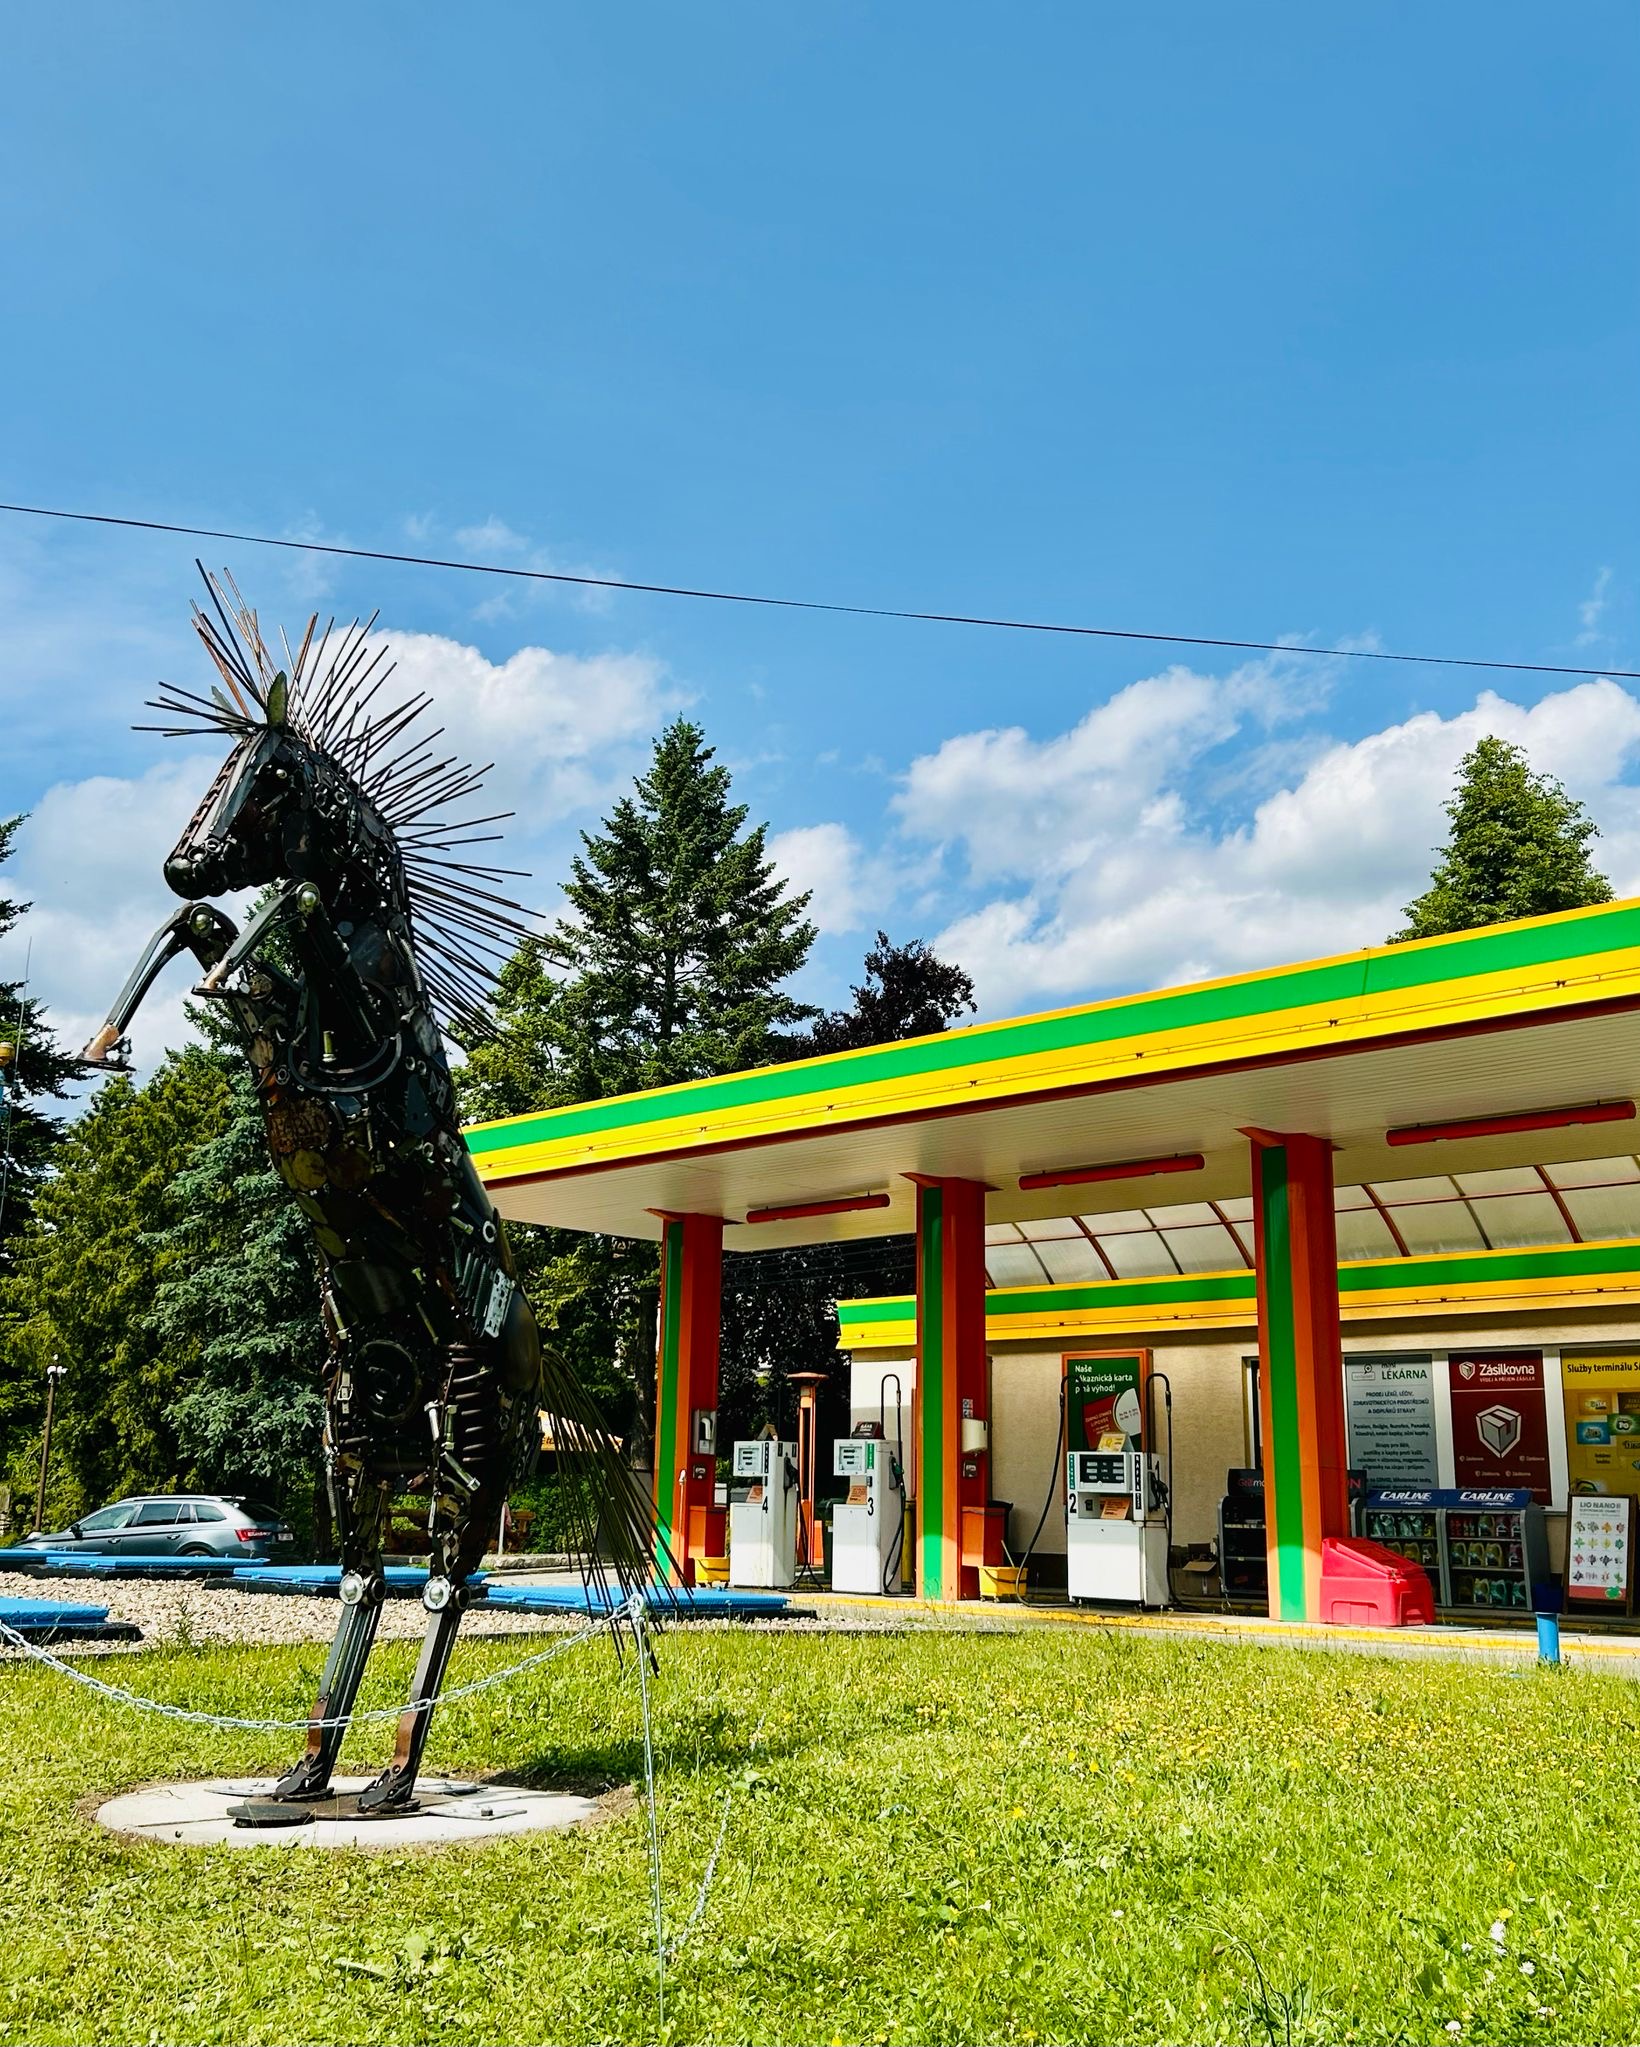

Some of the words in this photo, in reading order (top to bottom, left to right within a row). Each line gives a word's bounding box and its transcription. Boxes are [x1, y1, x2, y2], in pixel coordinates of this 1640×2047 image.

[1074, 1364, 1092, 1373] Naše
[1382, 1368, 1427, 1380] LÉKÁRNA
[1479, 1363, 1535, 1376] Zásilkovna
[1567, 1364, 1592, 1374] Služby
[1594, 1362, 1632, 1372] terminálu
[1113, 1374, 1133, 1382] karta
[1091, 1384, 1116, 1394] výhod!
[762, 1496, 768, 1514] 4
[867, 1497, 874, 1516] 3
[1069, 1493, 1077, 1513] 2
